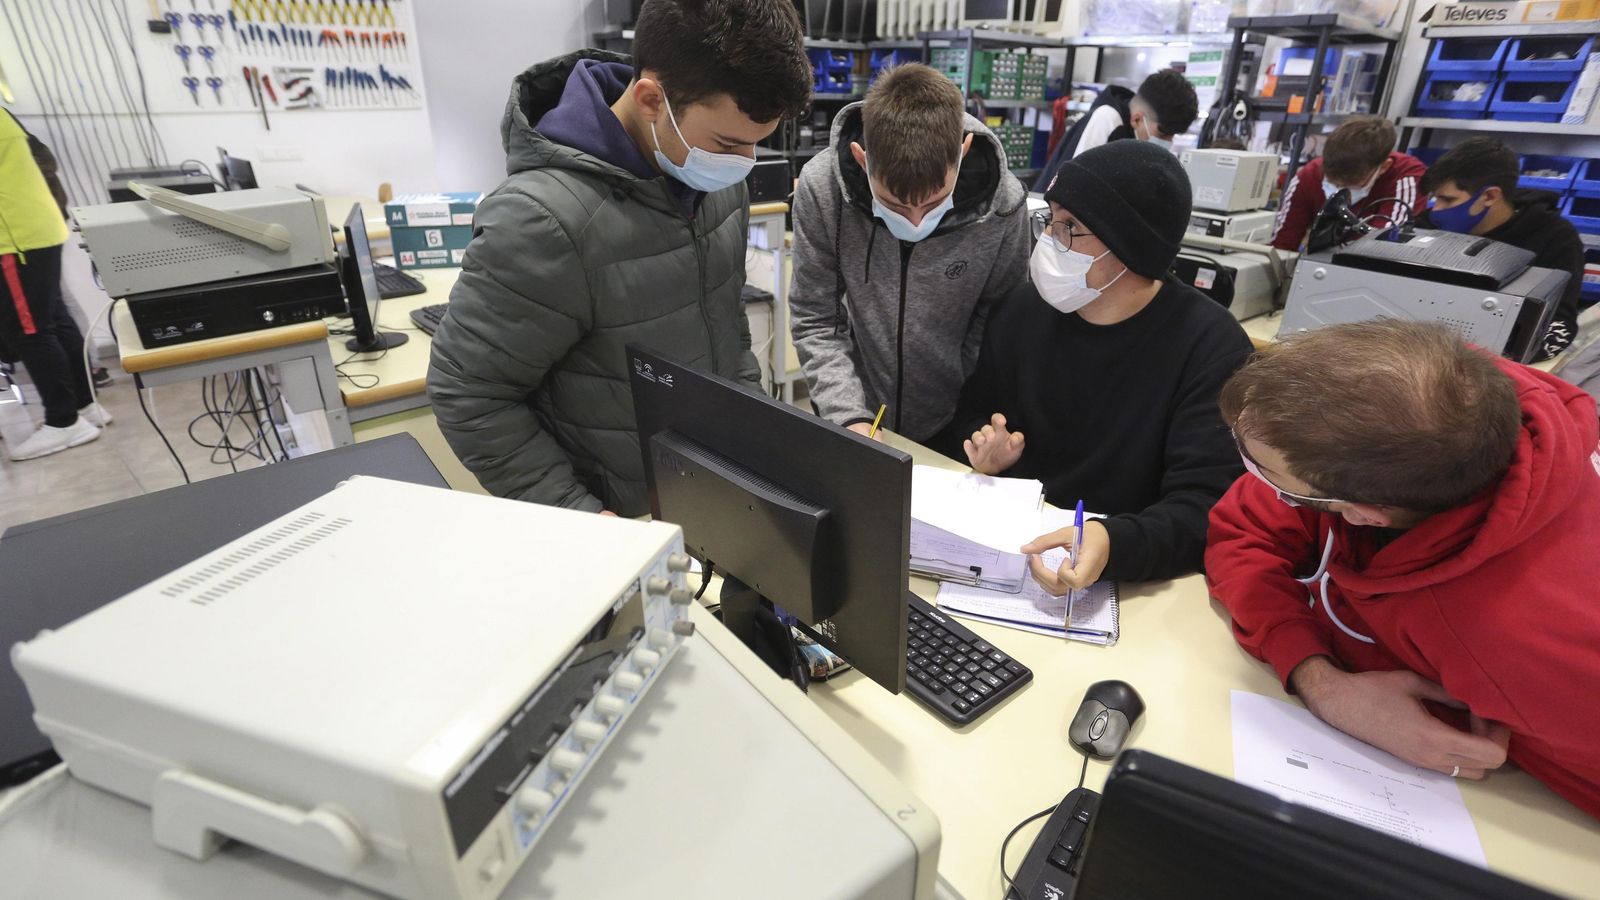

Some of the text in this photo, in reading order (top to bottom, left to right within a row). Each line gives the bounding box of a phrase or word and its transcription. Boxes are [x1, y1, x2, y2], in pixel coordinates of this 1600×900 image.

[1445, 6, 1508, 21] Televes
[392, 211, 403, 221] A4
[428, 231, 439, 245] 6
[401, 254, 413, 263] A4
